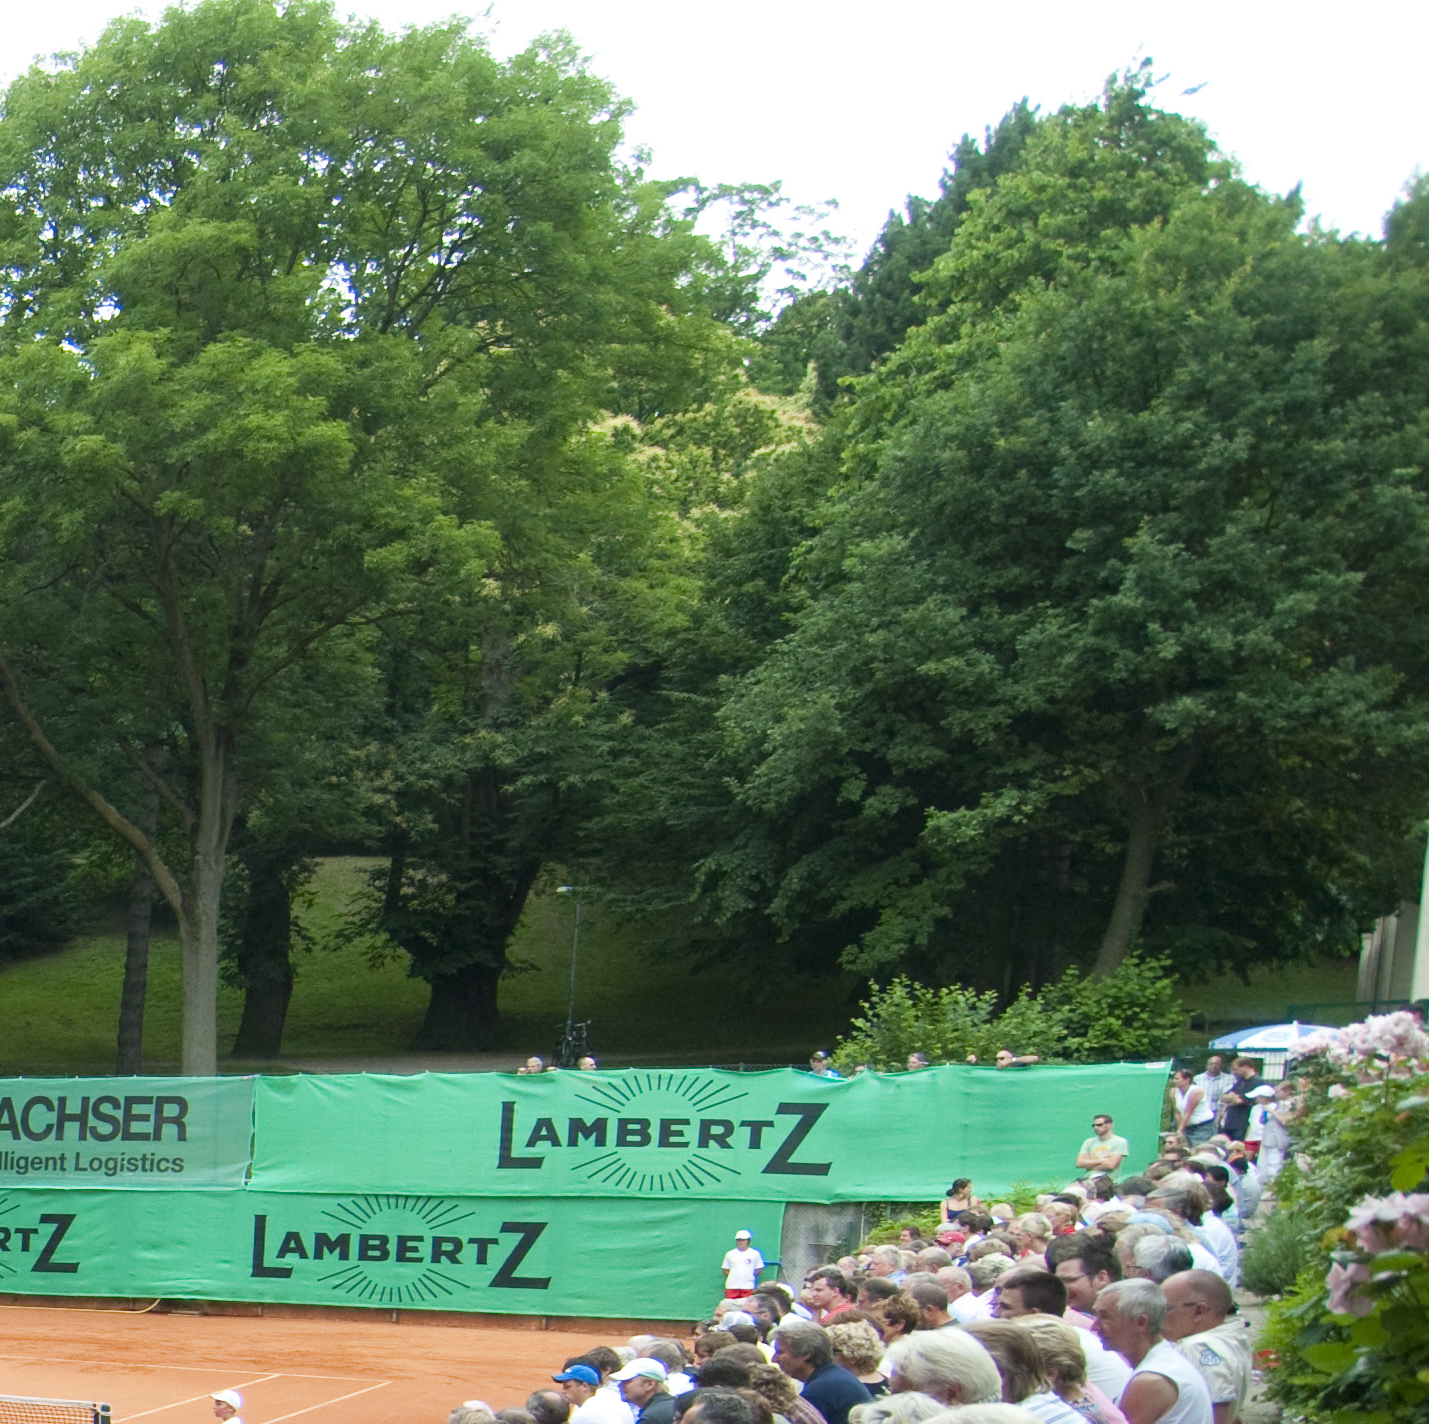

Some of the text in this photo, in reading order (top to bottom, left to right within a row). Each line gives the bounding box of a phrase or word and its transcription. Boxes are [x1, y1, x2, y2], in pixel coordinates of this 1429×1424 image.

[74, 1151, 185, 1177] Logistics
[496, 1100, 833, 1176] LAMBERTZ
[250, 1213, 553, 1290] LAMBERTZ
